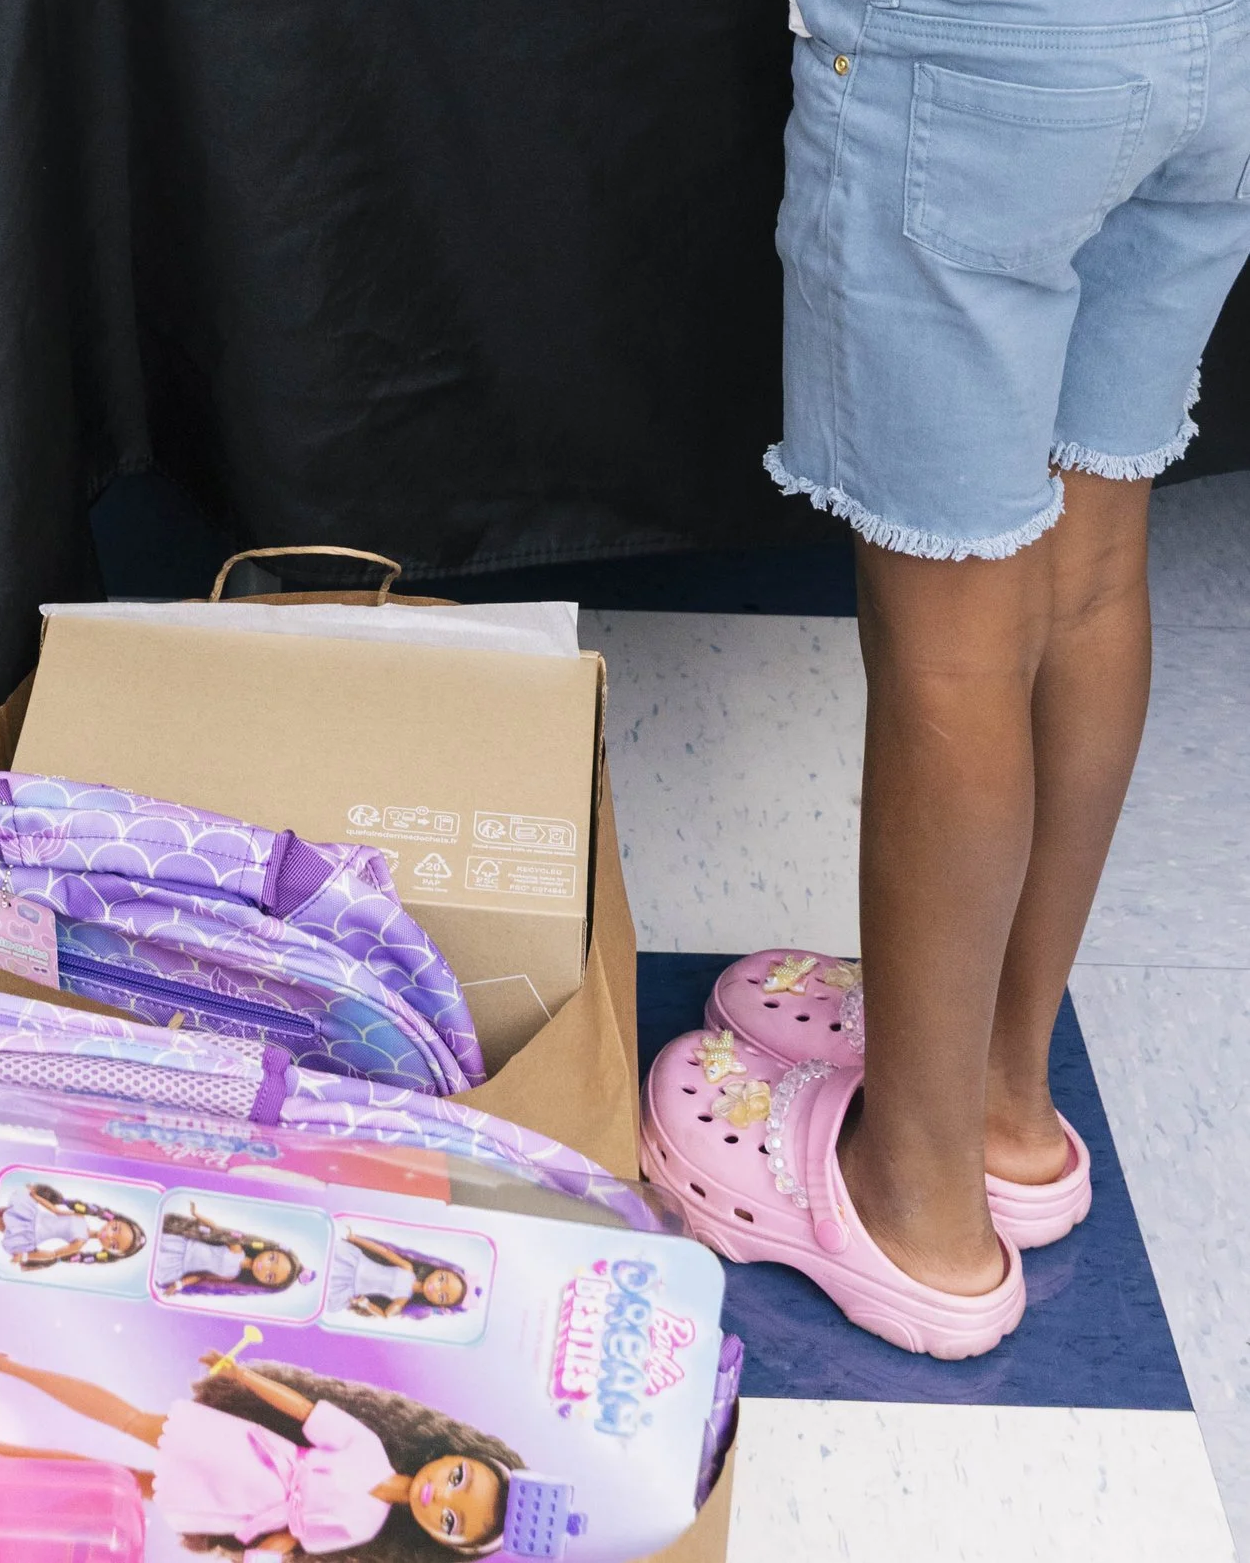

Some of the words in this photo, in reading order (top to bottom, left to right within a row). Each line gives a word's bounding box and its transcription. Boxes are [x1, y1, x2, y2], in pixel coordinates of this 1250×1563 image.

[425, 863, 441, 871] 20
[554, 1277, 612, 1400] BESTIES
[593, 1260, 658, 1438] DREAM
[646, 1306, 697, 1396] Barbie
